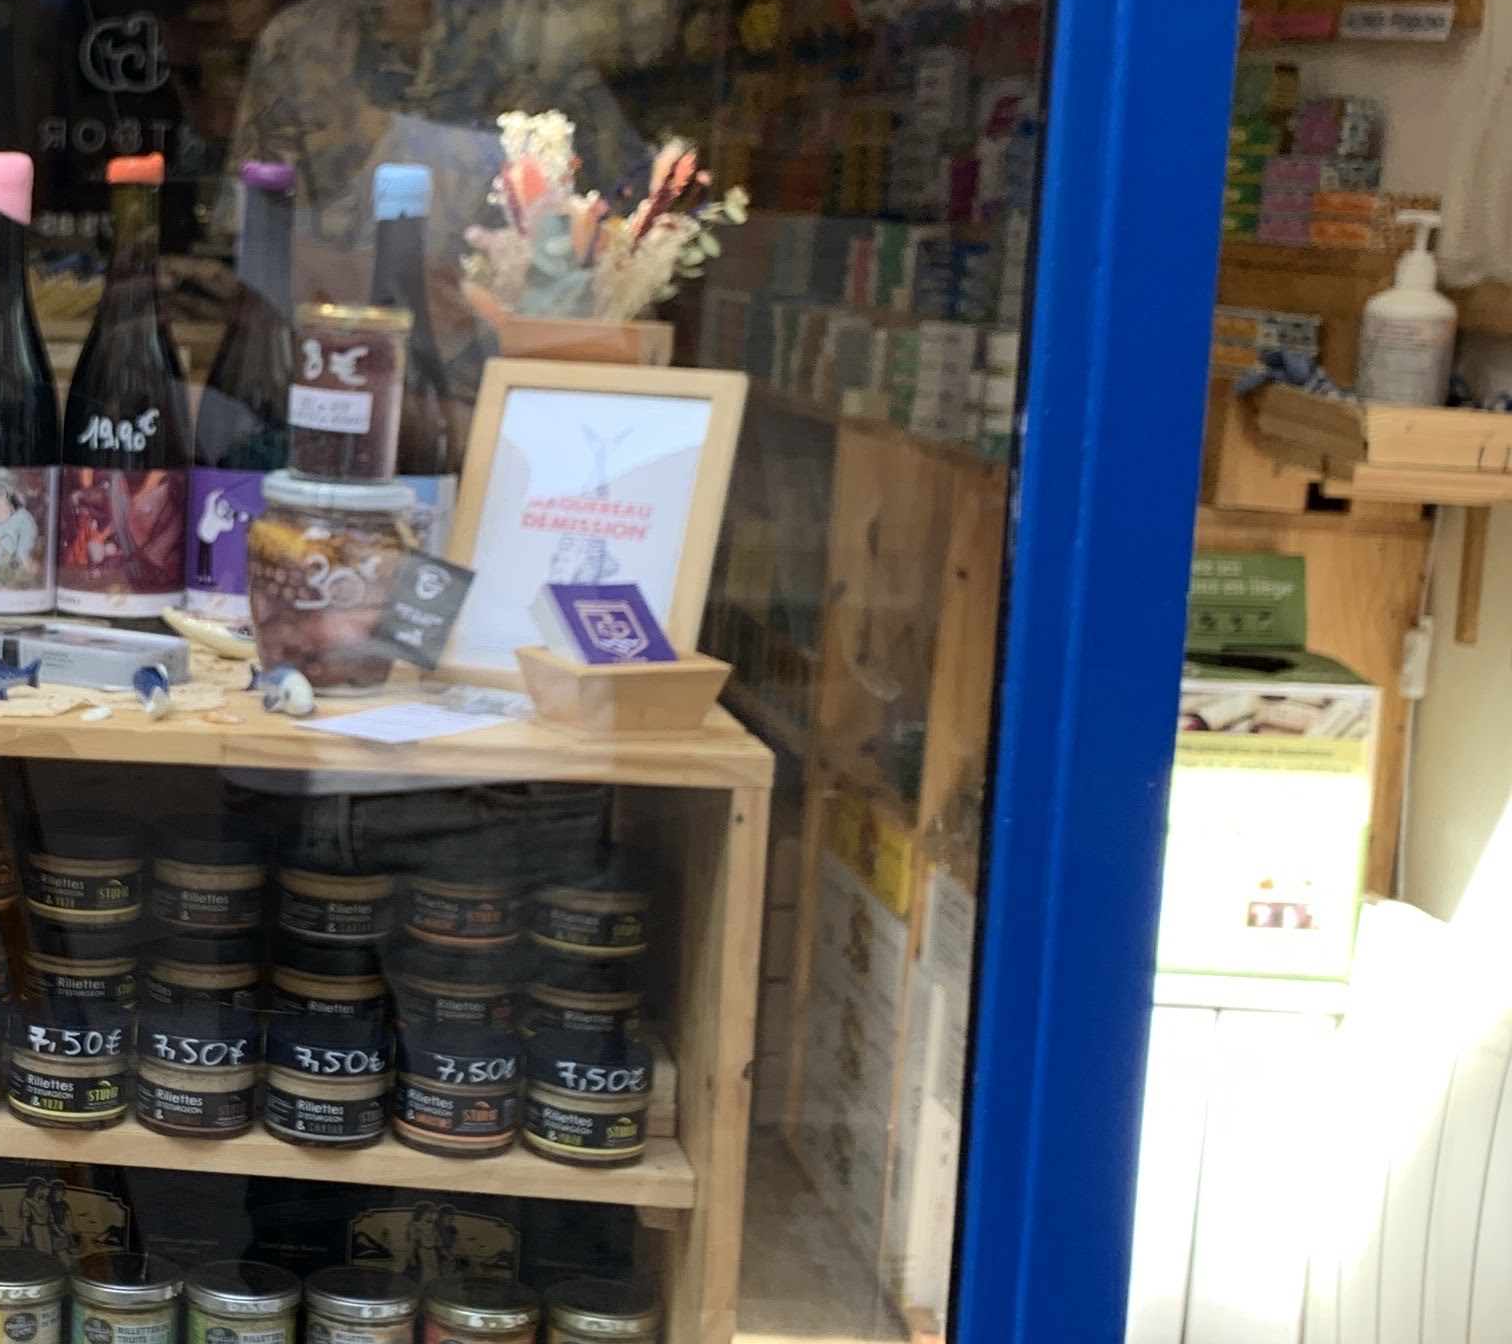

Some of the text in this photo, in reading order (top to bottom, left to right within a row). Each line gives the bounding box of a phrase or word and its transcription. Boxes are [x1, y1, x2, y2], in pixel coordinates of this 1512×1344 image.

[41, 873, 85, 890] Rillettes
[181, 890, 230, 906] Rillettes
[328, 903, 373, 915] Rillettes
[57, 976, 106, 991] Rillettes
[308, 1001, 355, 1015] Rillettes
[28, 1024, 123, 1054] 7,50€
[152, 1033, 248, 1066] 7,50€
[27, 1074, 75, 1091] Rillettes
[154, 1088, 204, 1107] Rillettes
[408, 1088, 454, 1110] Rillettes
[297, 1100, 345, 1116] Rillettes
[543, 1106, 593, 1128] Rillettes
